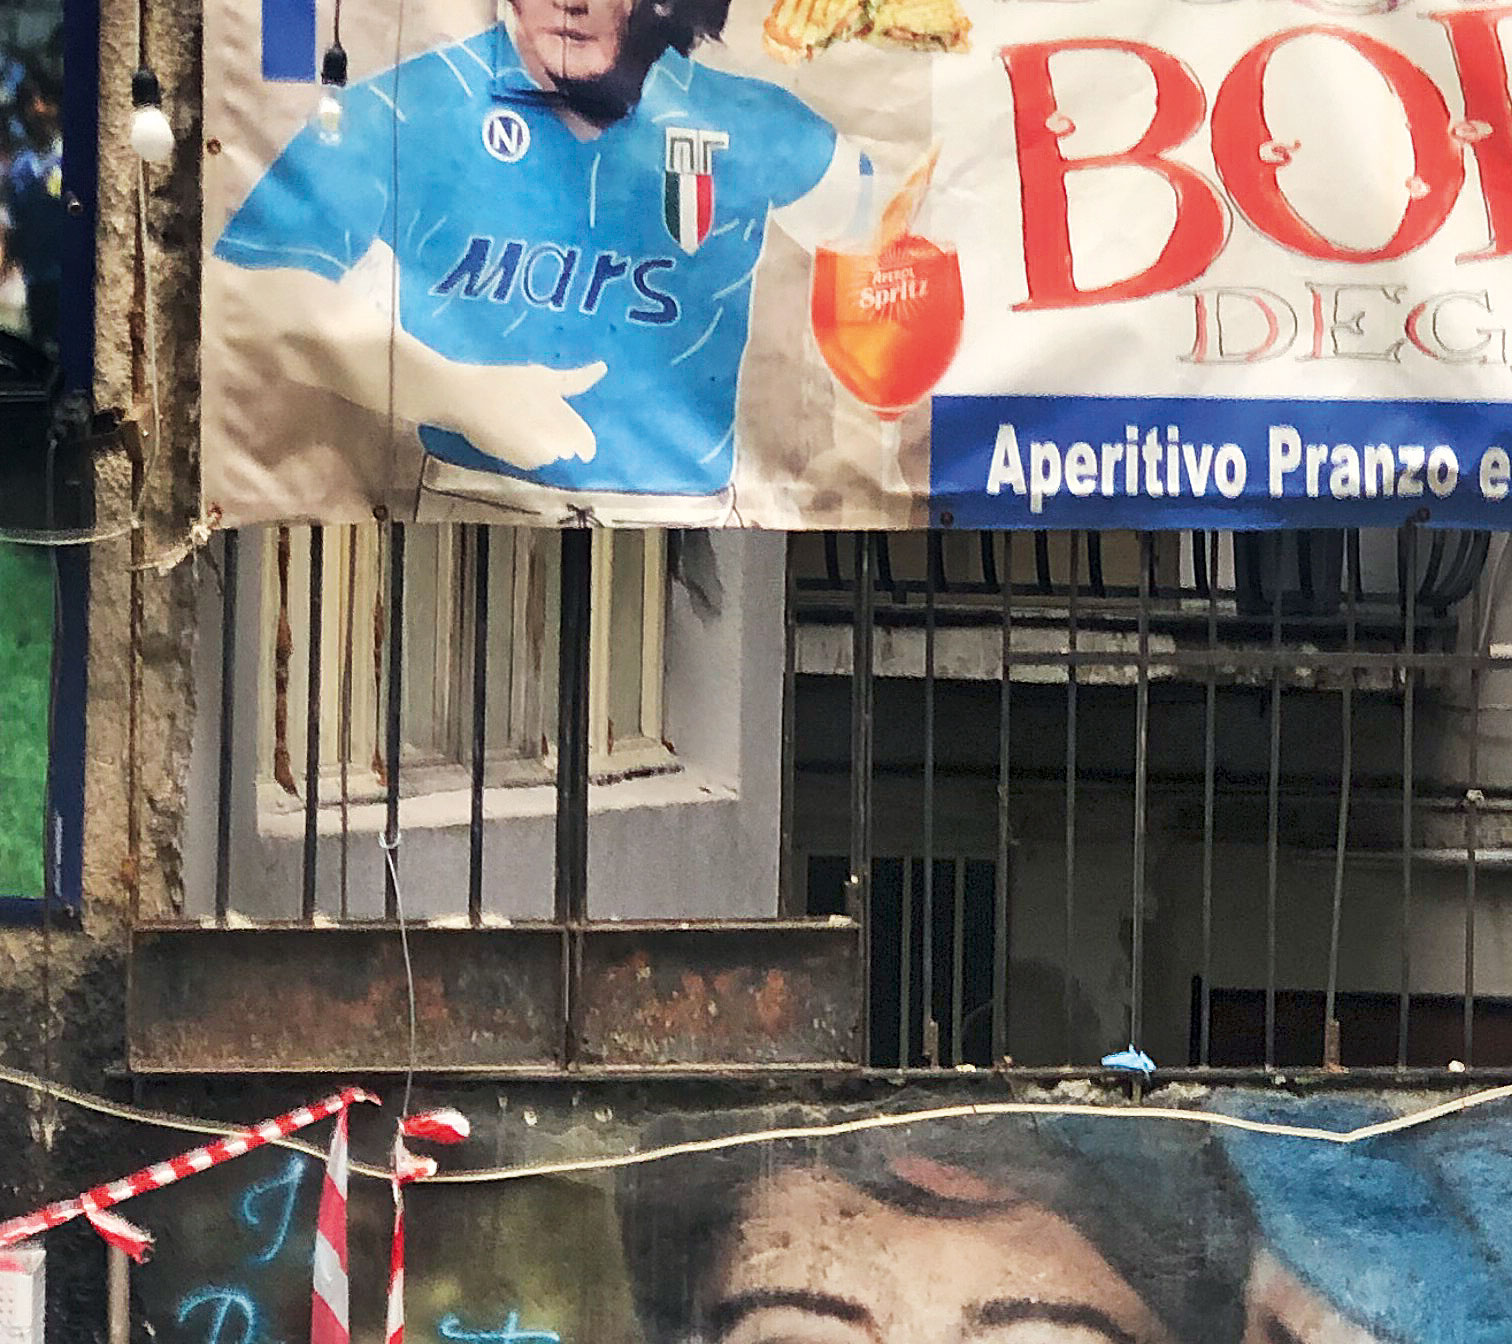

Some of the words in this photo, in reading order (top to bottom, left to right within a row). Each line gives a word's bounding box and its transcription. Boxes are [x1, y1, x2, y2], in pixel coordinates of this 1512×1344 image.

[986, 422, 1248, 514] Aperitivo
[1268, 423, 1461, 499] Pranzo
[1479, 446, 1511, 501] e
